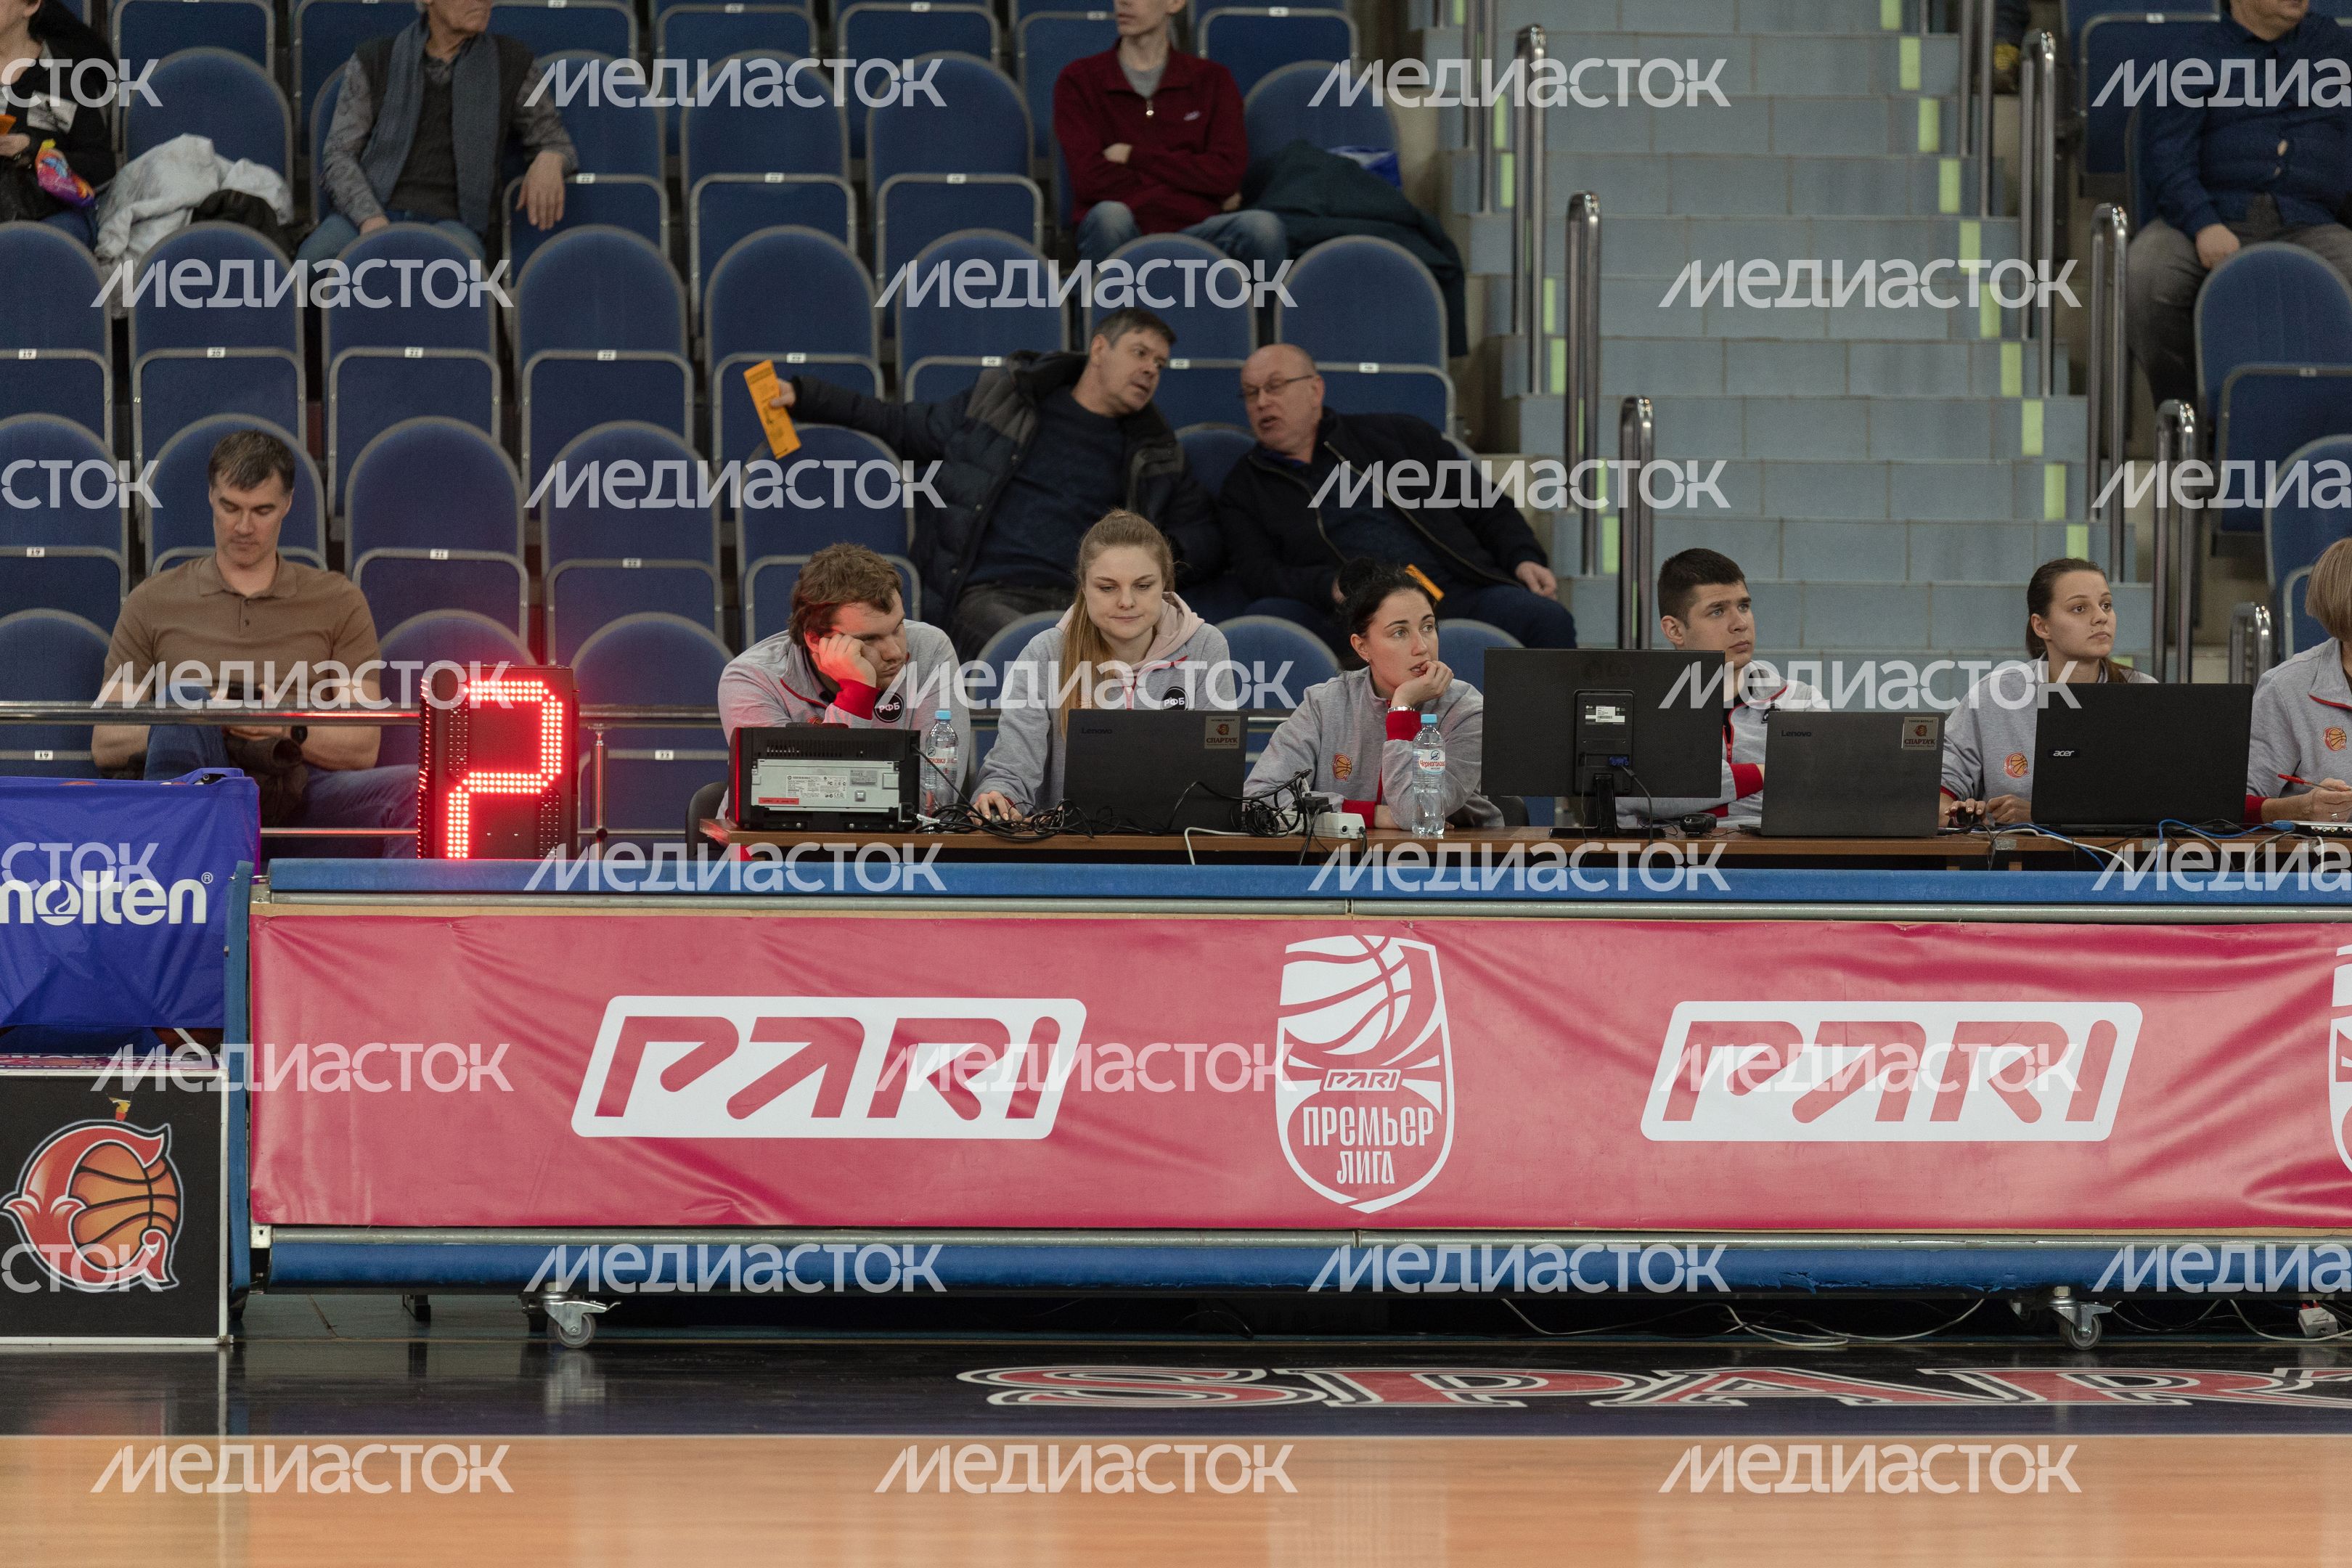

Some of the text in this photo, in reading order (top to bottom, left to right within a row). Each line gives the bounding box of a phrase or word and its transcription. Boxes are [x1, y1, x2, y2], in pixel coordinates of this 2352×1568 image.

[878, 702, 900, 713] РФБ
[1164, 697, 1185, 707] РФБ
[594, 1016, 1061, 1122] PARI
[1326, 1071, 1400, 1090] PARI
[1662, 1019, 2118, 1124] PARI
[1302, 1105, 1434, 1146] ПРЕМЬЕР
[1335, 1150, 1395, 1185] ЛИГА
